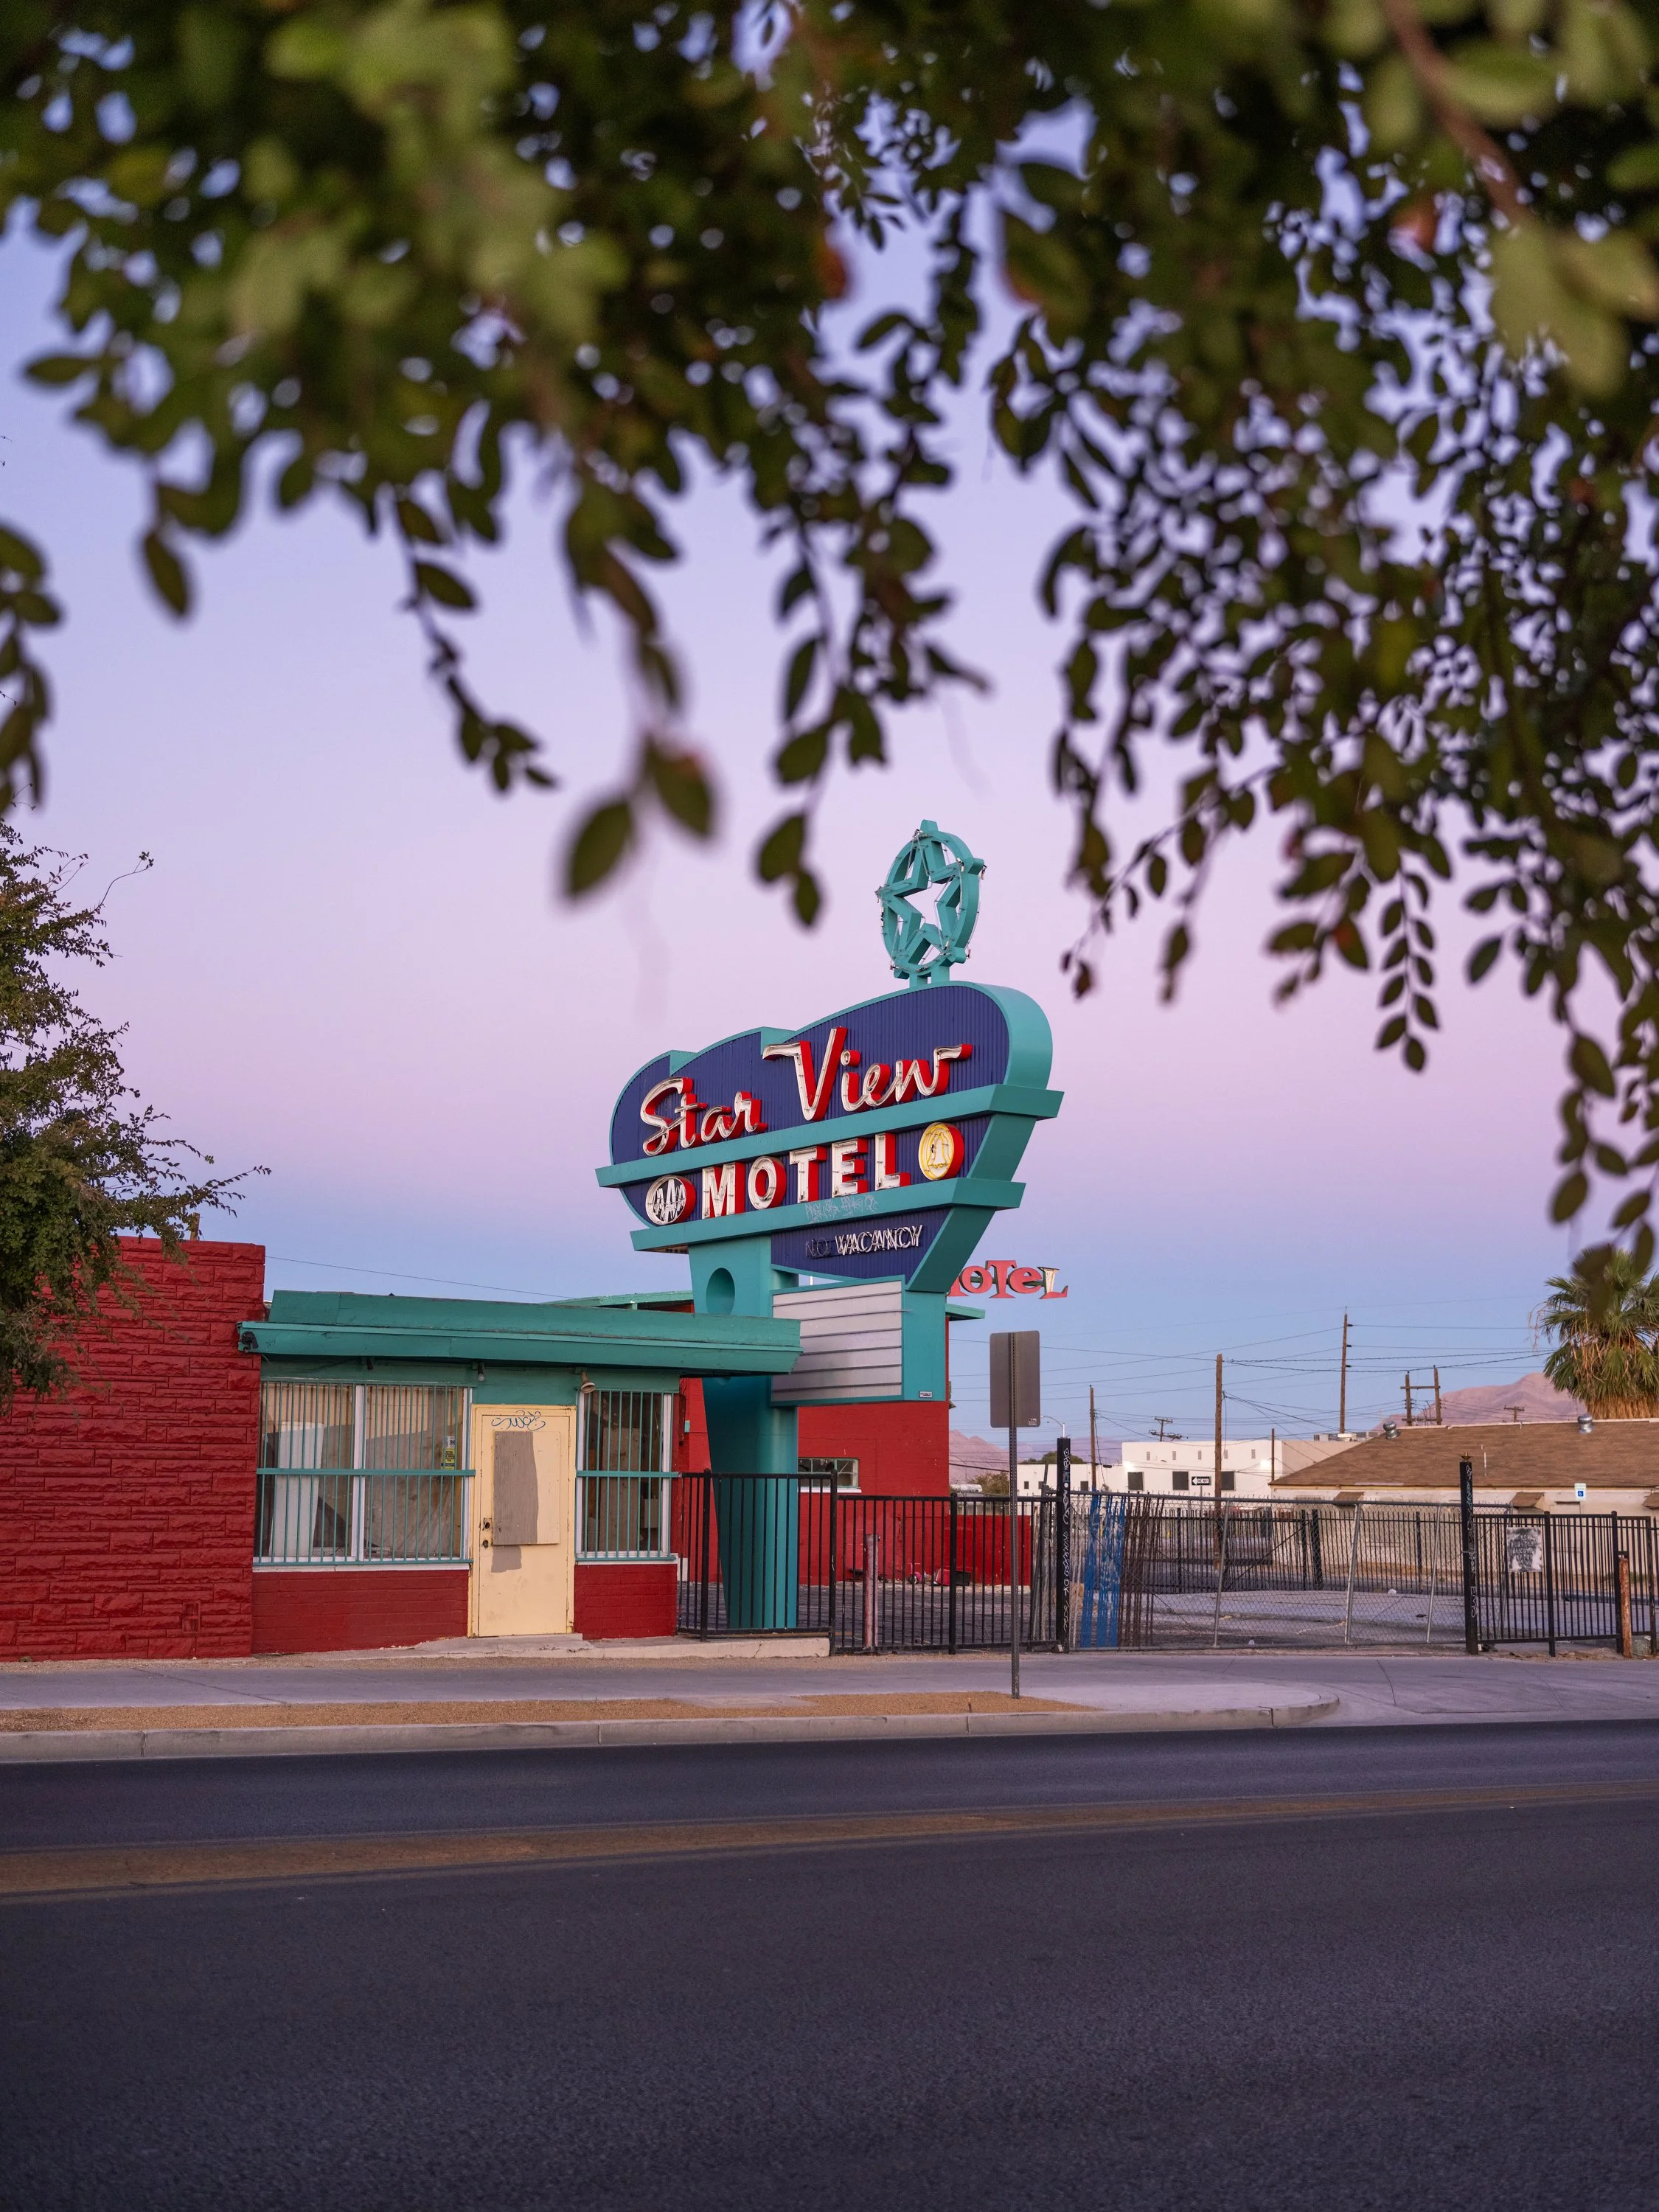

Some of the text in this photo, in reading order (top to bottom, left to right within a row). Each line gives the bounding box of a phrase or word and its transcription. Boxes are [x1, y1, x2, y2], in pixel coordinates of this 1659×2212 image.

[640, 1027, 973, 1156] Star View
[702, 1133, 911, 1220] MOTEL
[805, 1224, 923, 1258] NO VACANCY
